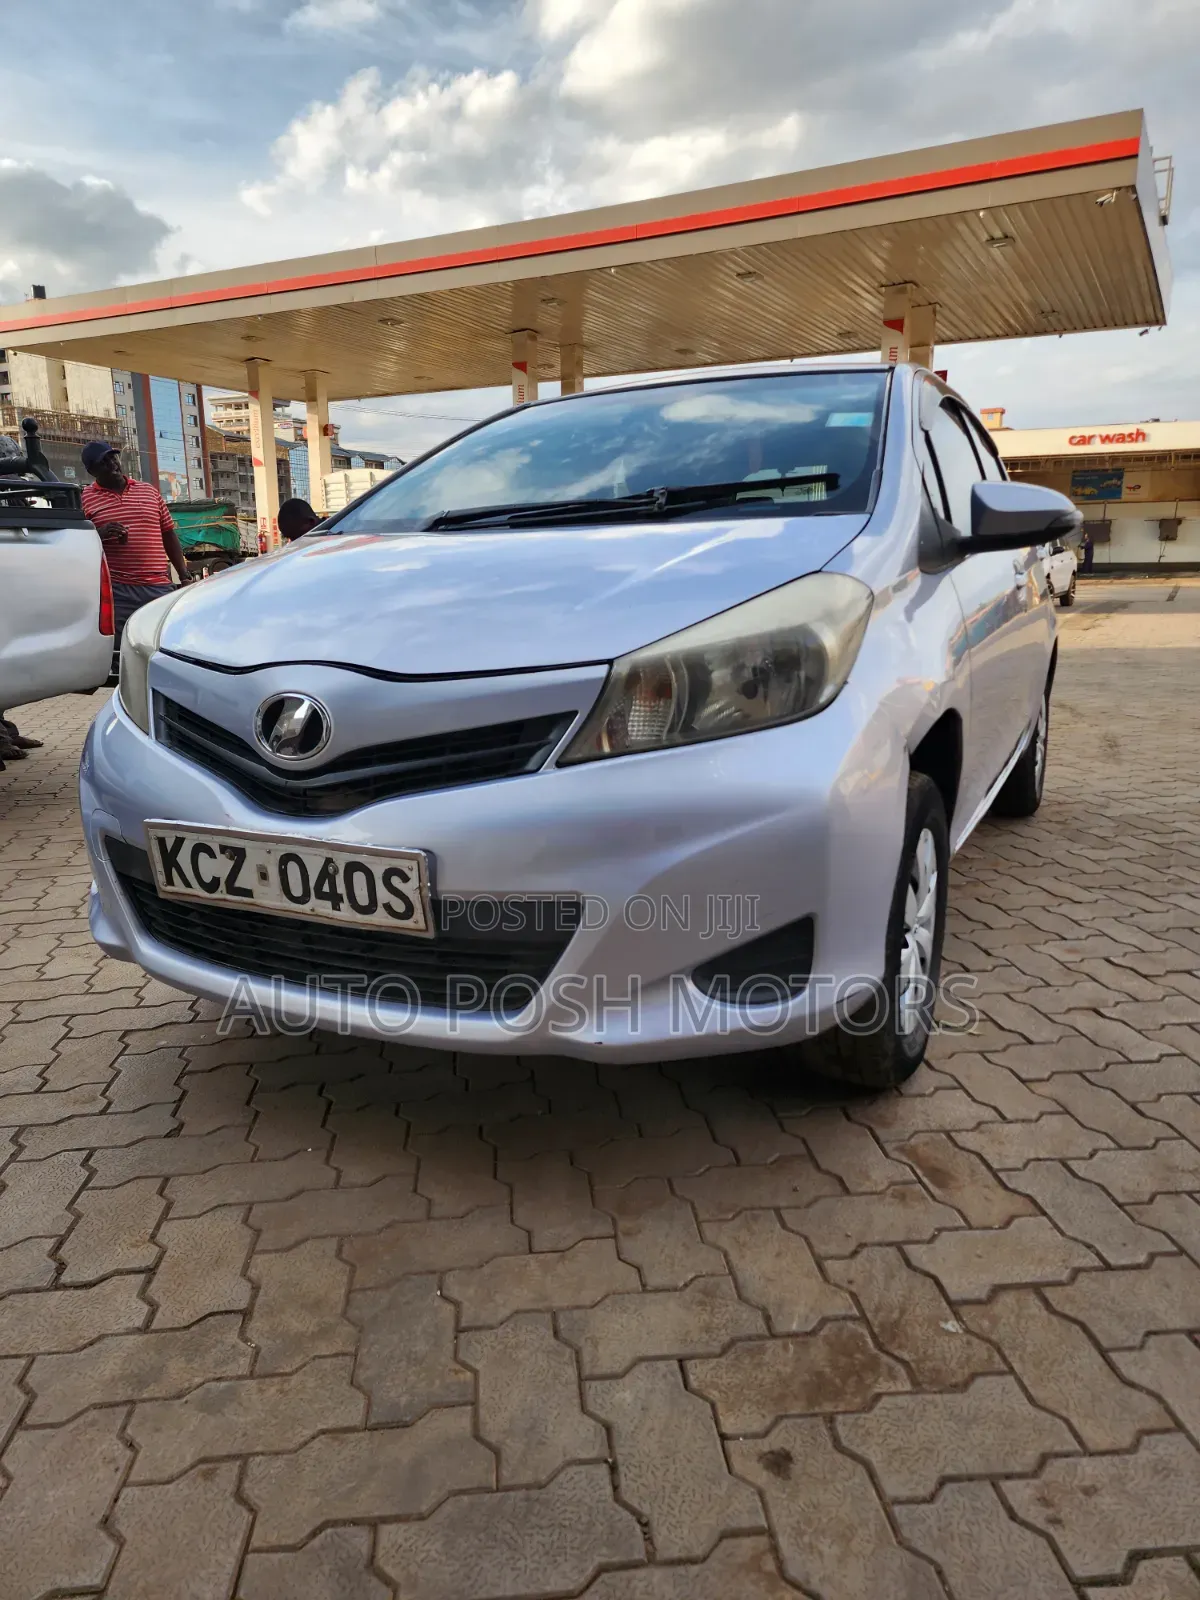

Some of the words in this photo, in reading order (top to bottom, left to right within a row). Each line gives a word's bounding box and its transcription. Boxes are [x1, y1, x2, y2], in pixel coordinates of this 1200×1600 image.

[1068, 433, 1096, 446] car
[1099, 428, 1147, 444] wash
[157, 836, 254, 899] KCZ
[278, 852, 415, 921] 040S
